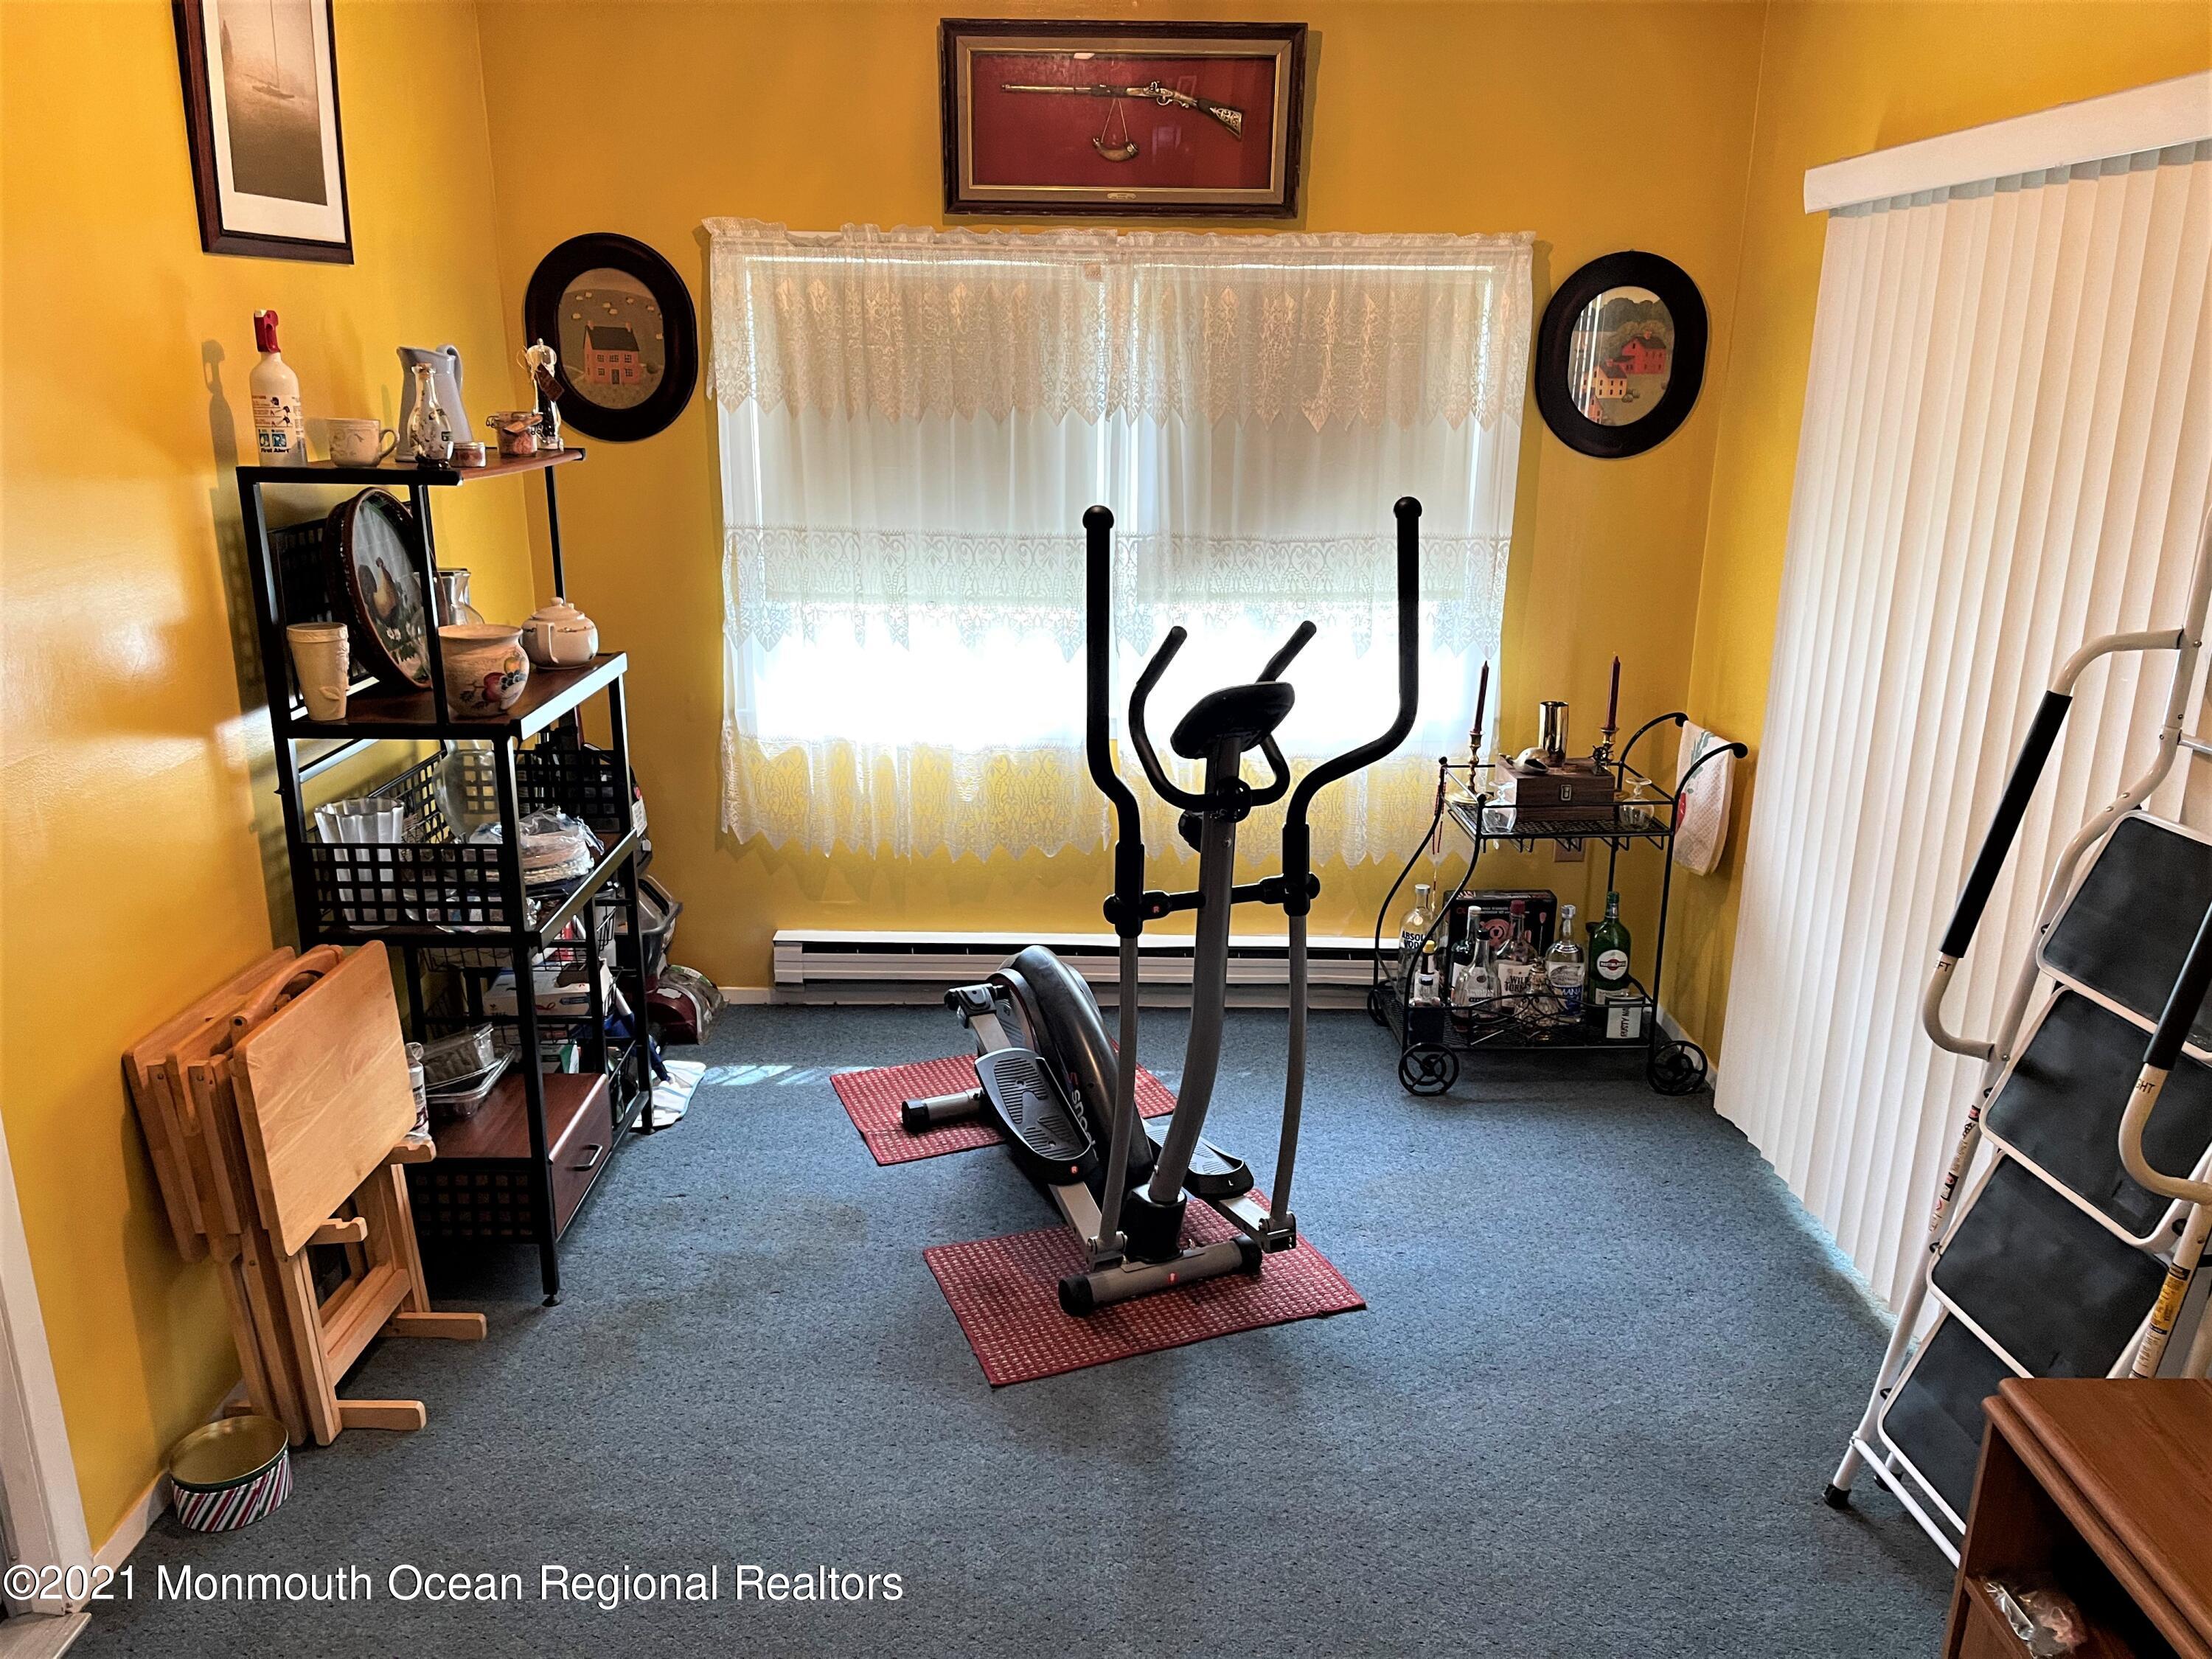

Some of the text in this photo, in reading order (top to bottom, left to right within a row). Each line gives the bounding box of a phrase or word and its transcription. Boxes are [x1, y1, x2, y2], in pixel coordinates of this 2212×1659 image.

[1402, 931, 1425, 942] ABSOL
[1404, 939, 1421, 949] VOD
[1620, 1017, 1630, 1037] RUSTY
